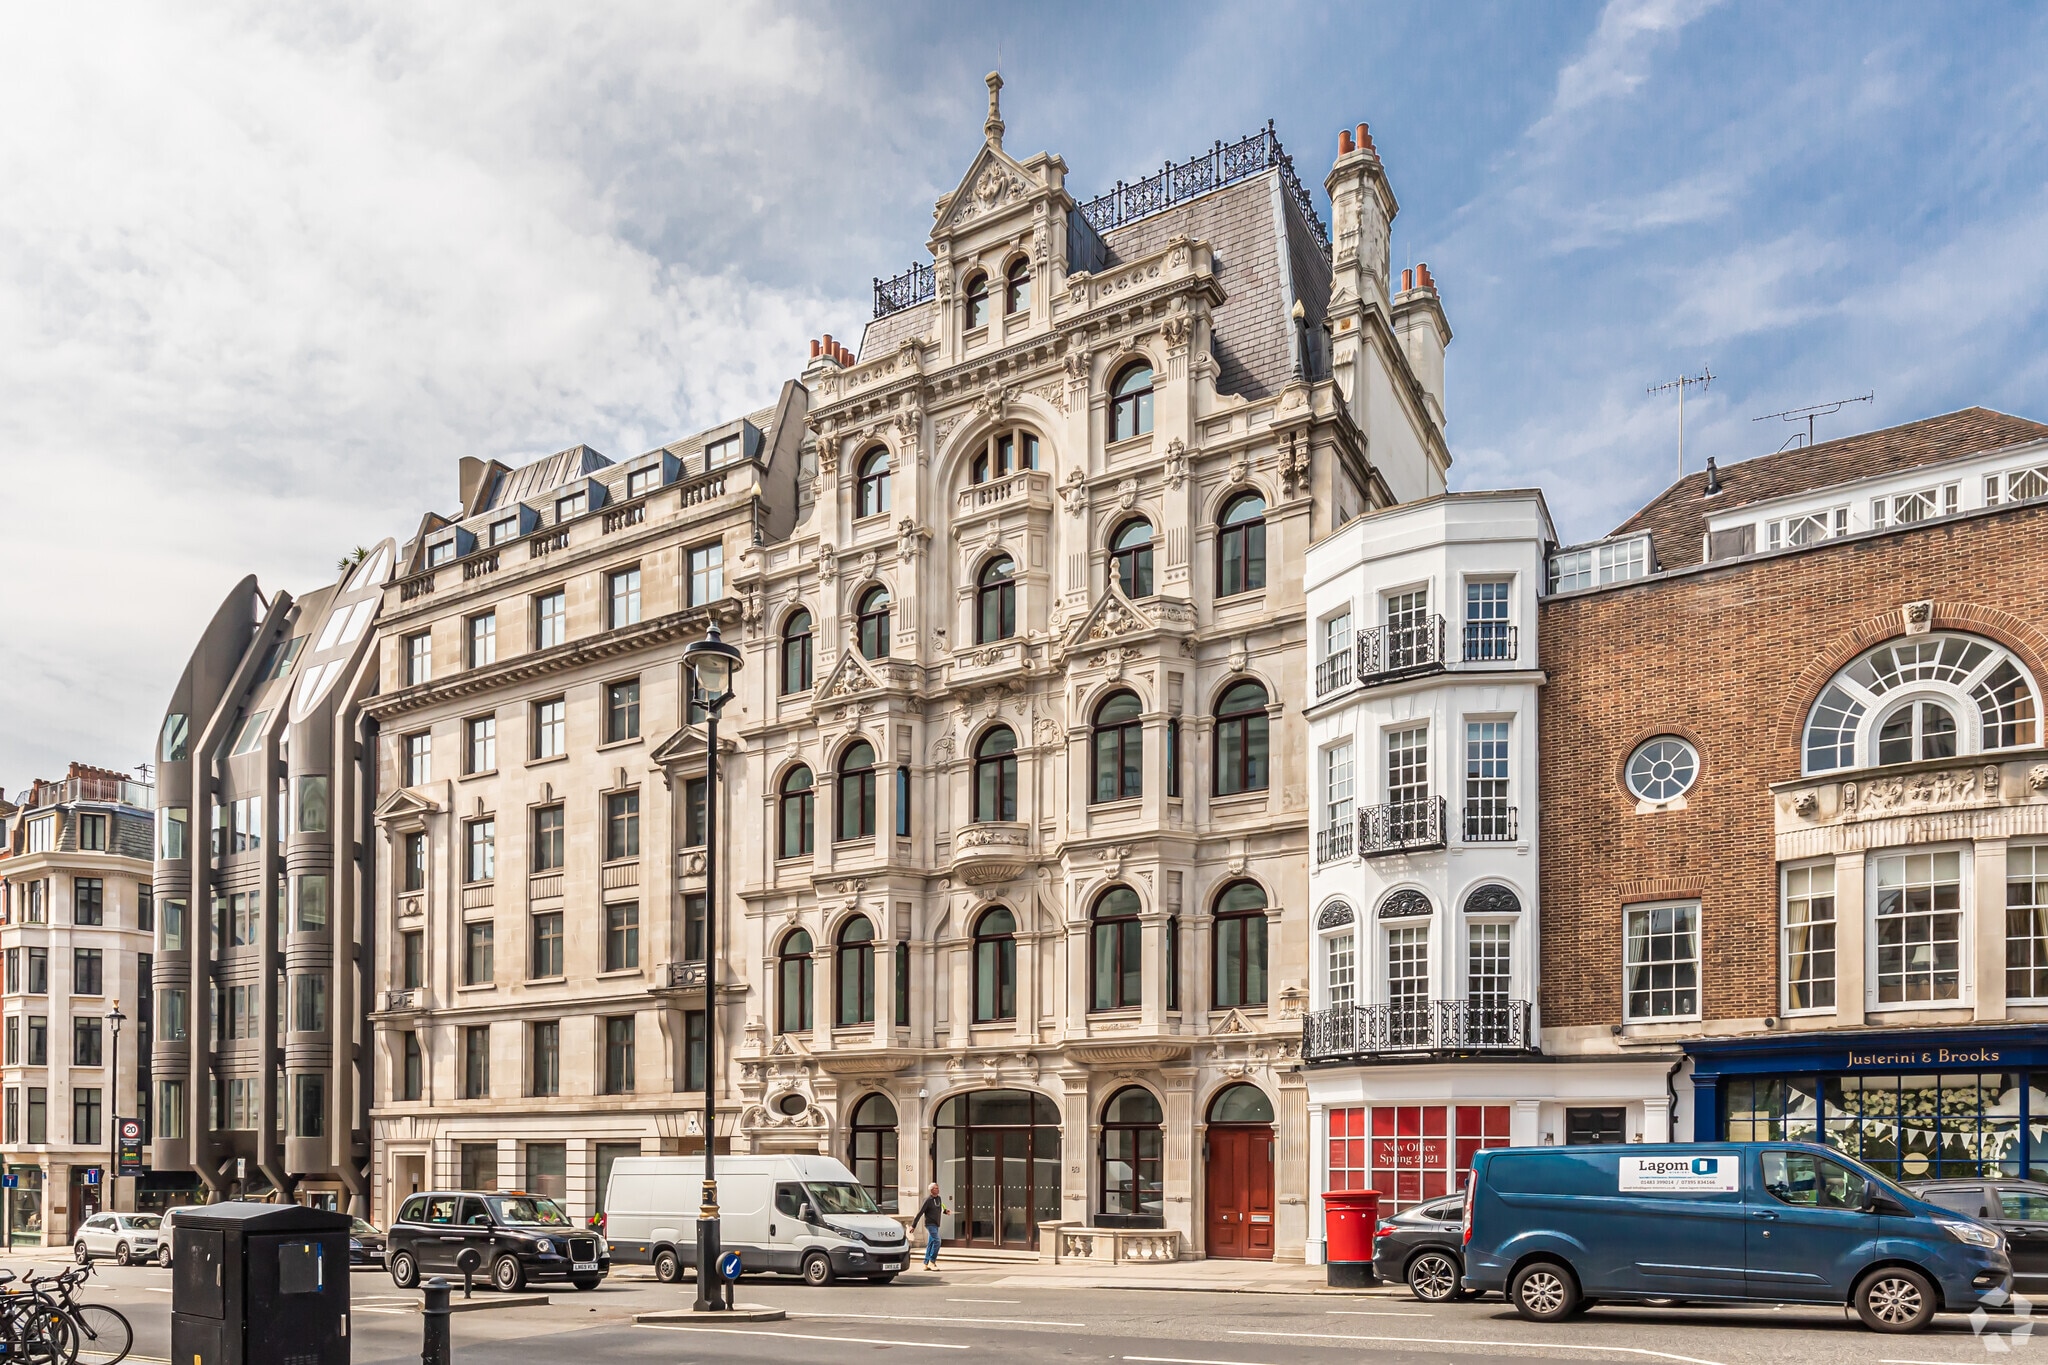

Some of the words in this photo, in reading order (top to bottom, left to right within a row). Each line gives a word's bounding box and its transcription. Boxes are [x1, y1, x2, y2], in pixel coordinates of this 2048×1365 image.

[1847, 1051, 1916, 1068] Justerini
[1921, 1053, 1932, 1063] &
[1939, 1048, 2000, 1063] Brooks
[126, 1126, 136, 1134] 20
[1639, 1160, 1690, 1174] Lagom
